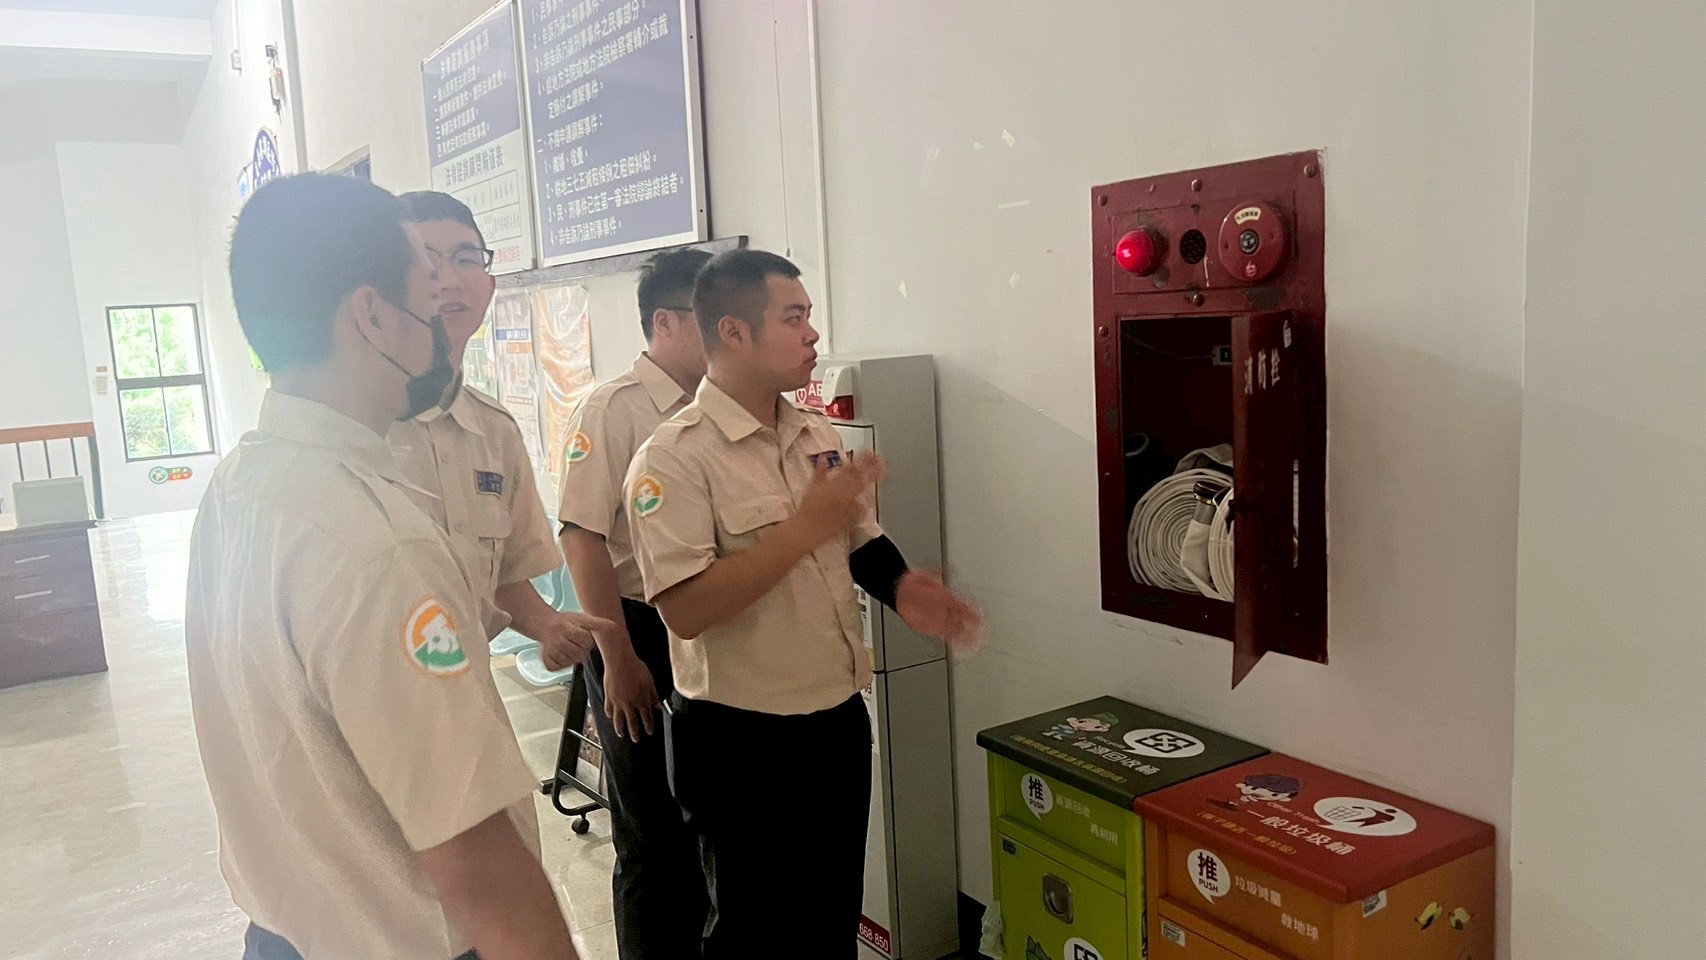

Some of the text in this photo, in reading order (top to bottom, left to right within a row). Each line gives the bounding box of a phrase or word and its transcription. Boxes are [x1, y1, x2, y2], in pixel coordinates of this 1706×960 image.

[1072, 739, 1160, 776] 資源回收桶
[1028, 775, 1044, 802] 推
[1029, 799, 1045, 811] PUSH
[1247, 810, 1356, 856] 一般垃圾桶
[1197, 851, 1218, 882] 推
[1198, 879, 1219, 894] PUSH
[1235, 875, 1282, 907] 垃圾減量
[1281, 913, 1319, 940] 救地球
